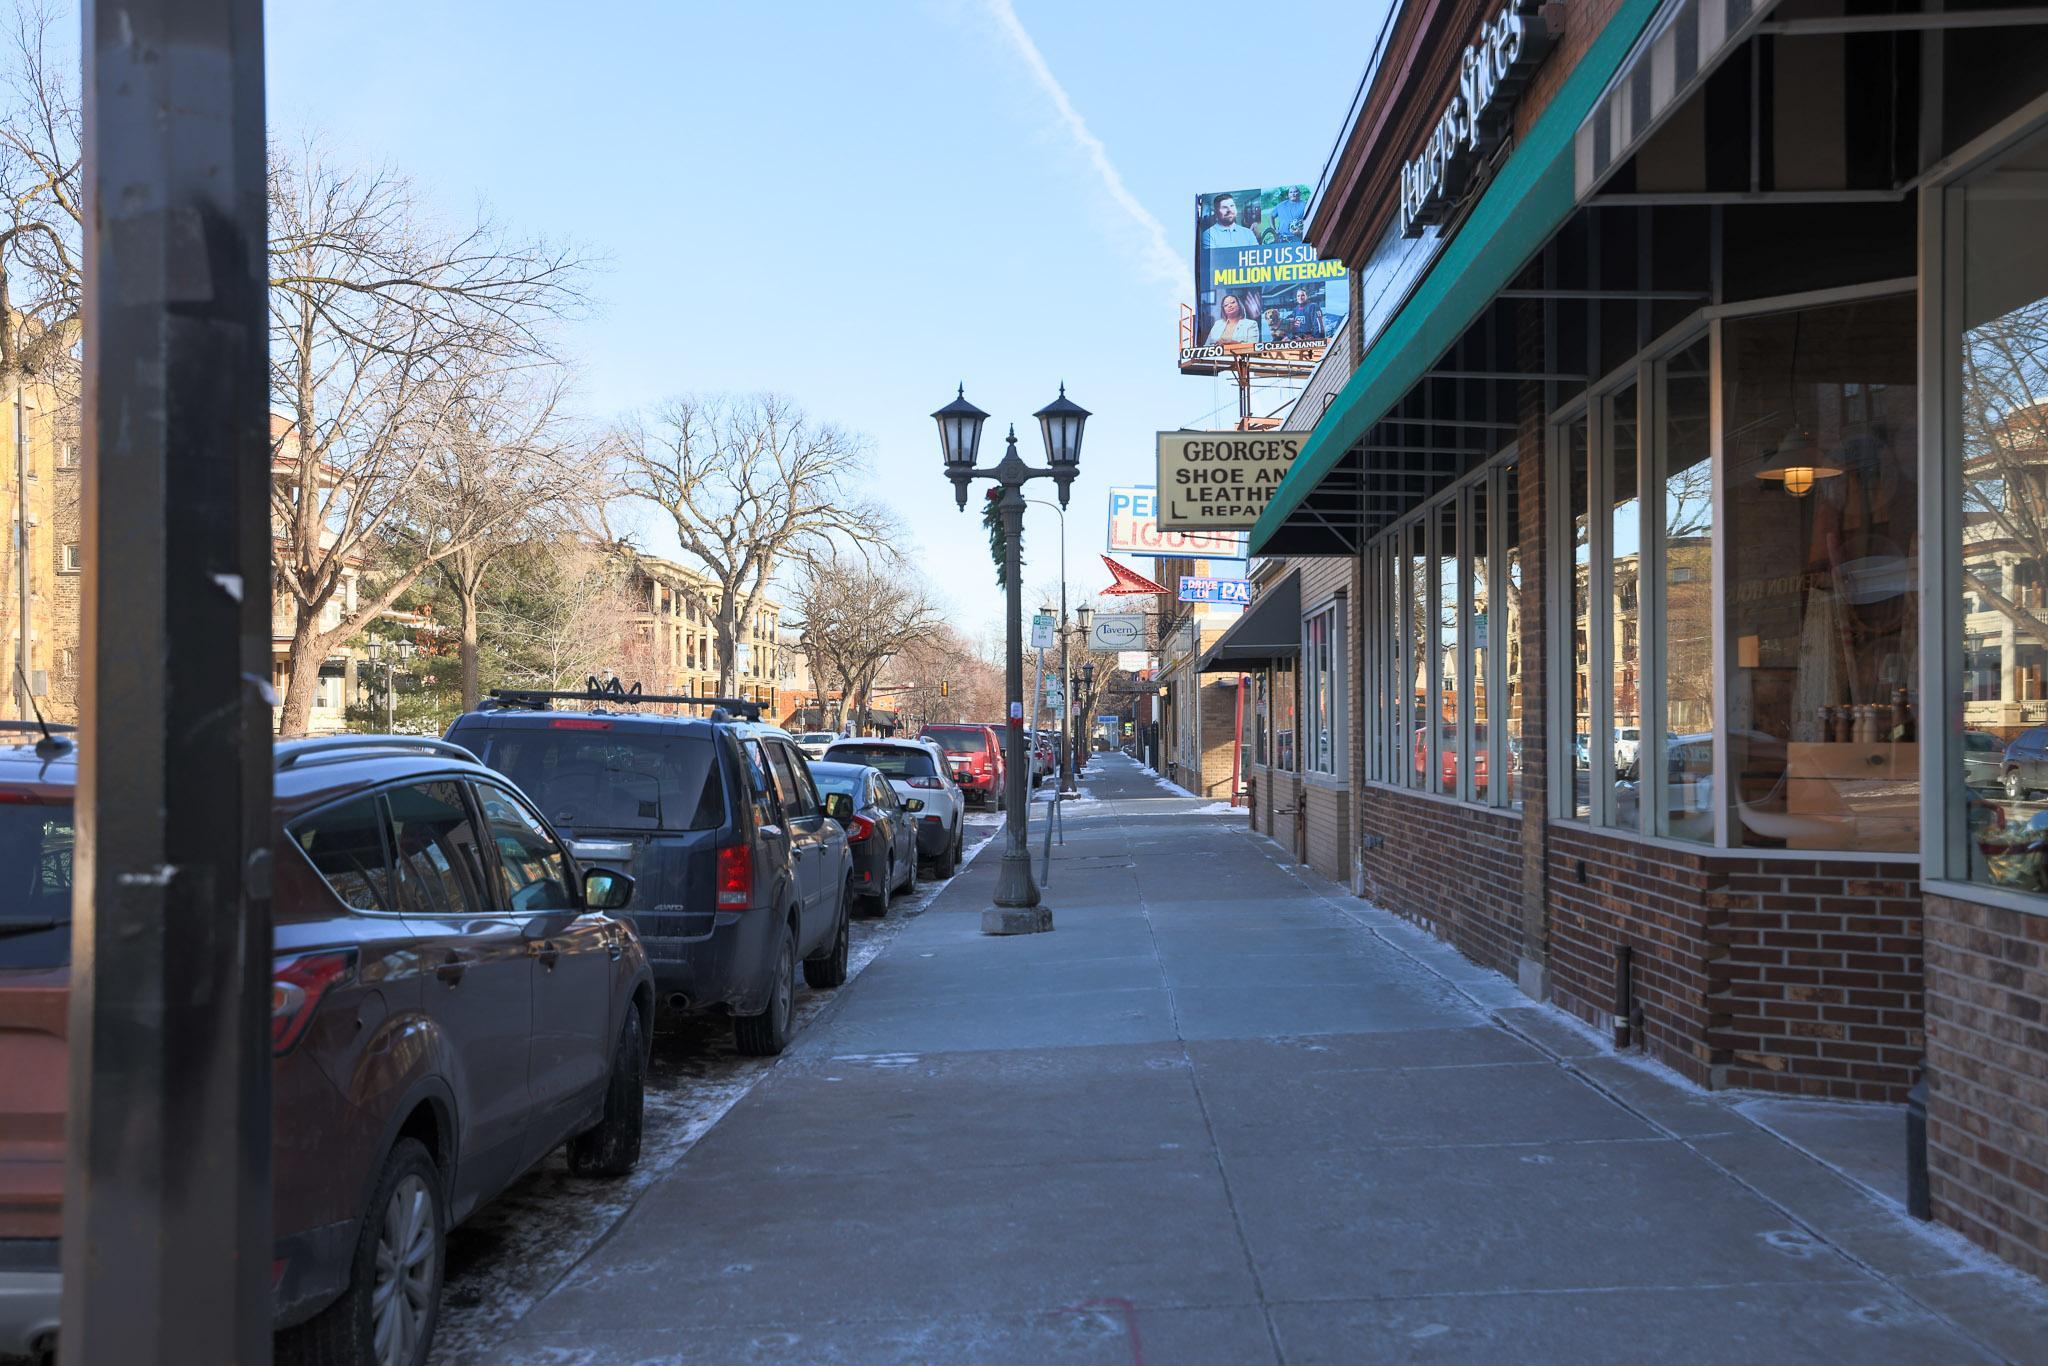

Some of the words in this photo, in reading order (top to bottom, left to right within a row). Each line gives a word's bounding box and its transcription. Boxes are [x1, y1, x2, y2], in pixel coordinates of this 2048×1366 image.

[1239, 249, 1272, 267] HELP
[1275, 246, 1293, 264] US
[1214, 265, 1271, 285] MILLION
[1273, 259, 1346, 281] VETERANS
[1182, 345, 1223, 358] 077750
[1183, 440, 1298, 461] GEORGE'S
[1176, 468, 1244, 484] SHOE
[1113, 494, 1157, 517] PE
[1102, 625, 1132, 634] Tavern
